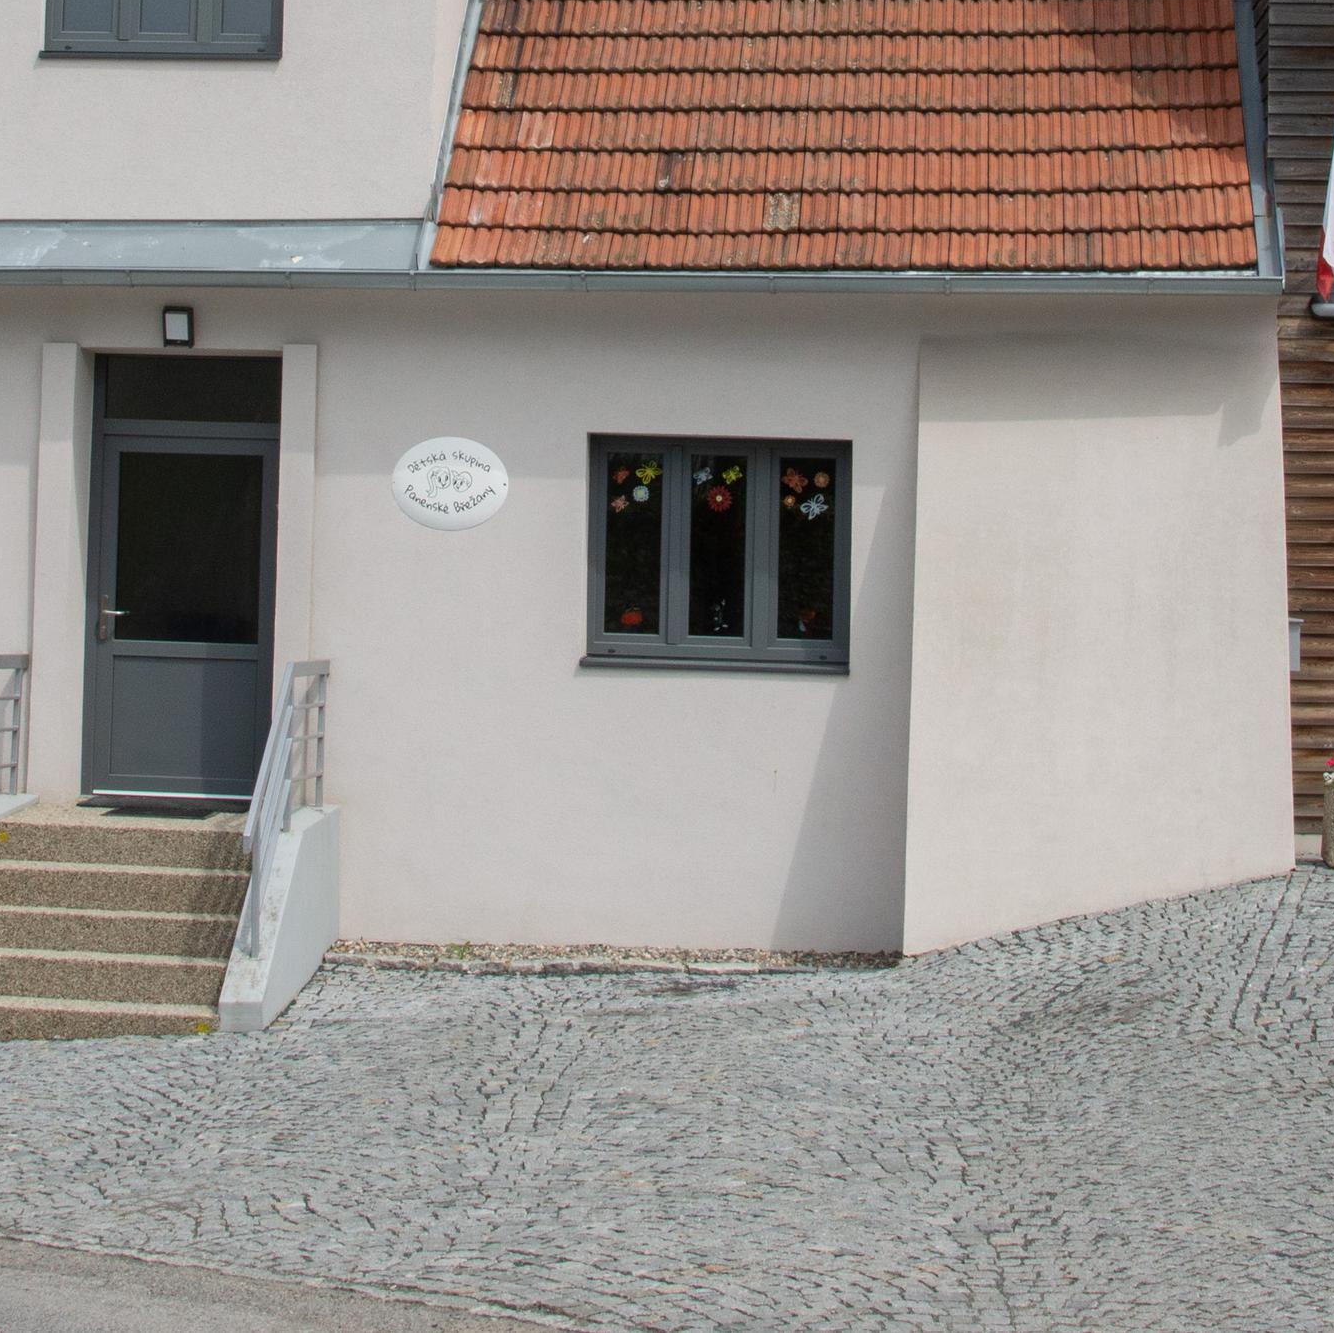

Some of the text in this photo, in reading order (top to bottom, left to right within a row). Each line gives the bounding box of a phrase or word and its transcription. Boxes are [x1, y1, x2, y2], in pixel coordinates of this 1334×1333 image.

[407, 450, 491, 473] Dětská skupina
[404, 484, 496, 514] Panenské Břežany
